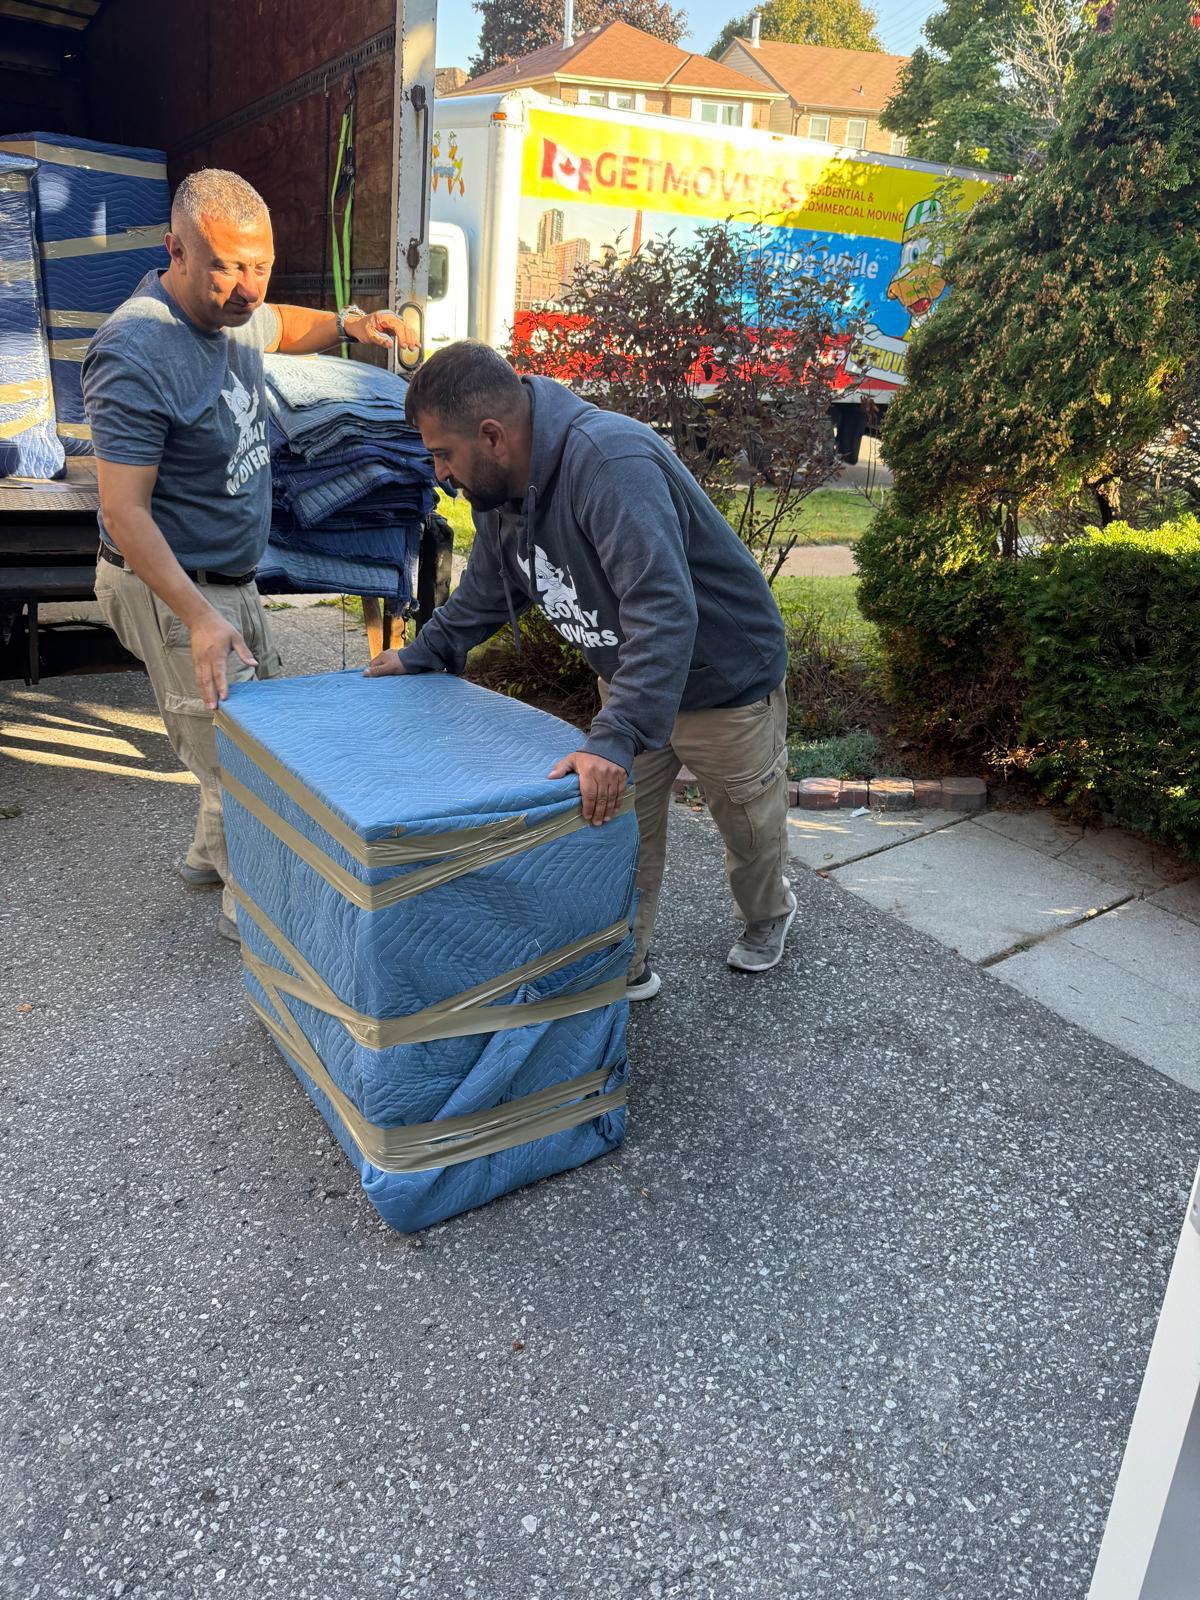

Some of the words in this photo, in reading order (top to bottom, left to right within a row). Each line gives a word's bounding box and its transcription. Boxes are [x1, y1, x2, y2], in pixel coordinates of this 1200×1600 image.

[867, 192, 874, 204] &
[801, 201, 865, 218] OMMERCIAL
[866, 208, 904, 224] MOVING
[226, 445, 270, 496] MOVER
[554, 622, 619, 648] OVERS
